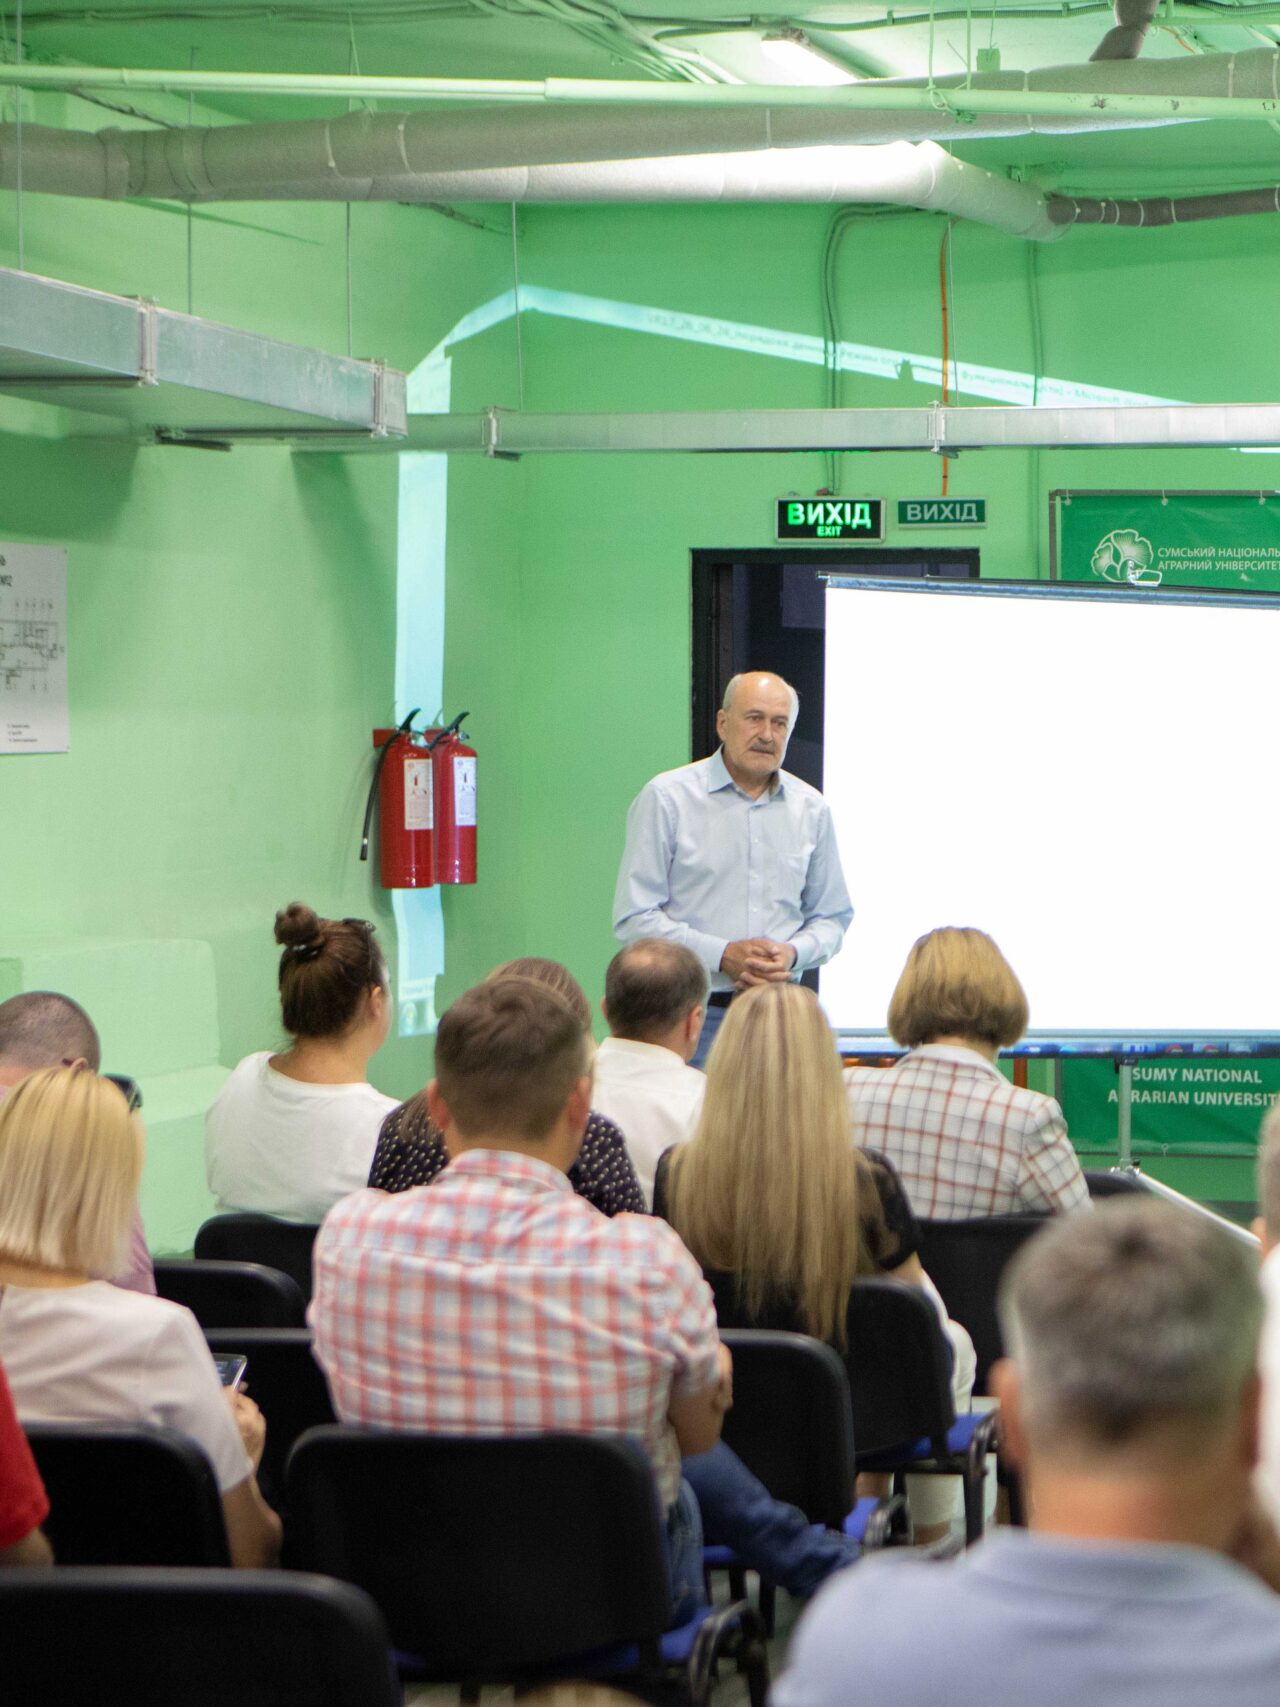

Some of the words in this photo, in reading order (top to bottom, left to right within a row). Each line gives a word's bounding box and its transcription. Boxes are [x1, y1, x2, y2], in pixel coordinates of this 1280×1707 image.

[788, 502, 871, 529] ВИХІД
[907, 503, 978, 521] ВИХІД
[817, 526, 842, 536] EXIT
[1158, 546, 1215, 557] СУМСЬКИЙ
[1158, 559, 1212, 570] АГРАРНИЙ
[1132, 1067, 1178, 1081] SUMY
[1182, 1069, 1262, 1083] NATIONAL
[1108, 1089, 1189, 1104] ARARIAN
